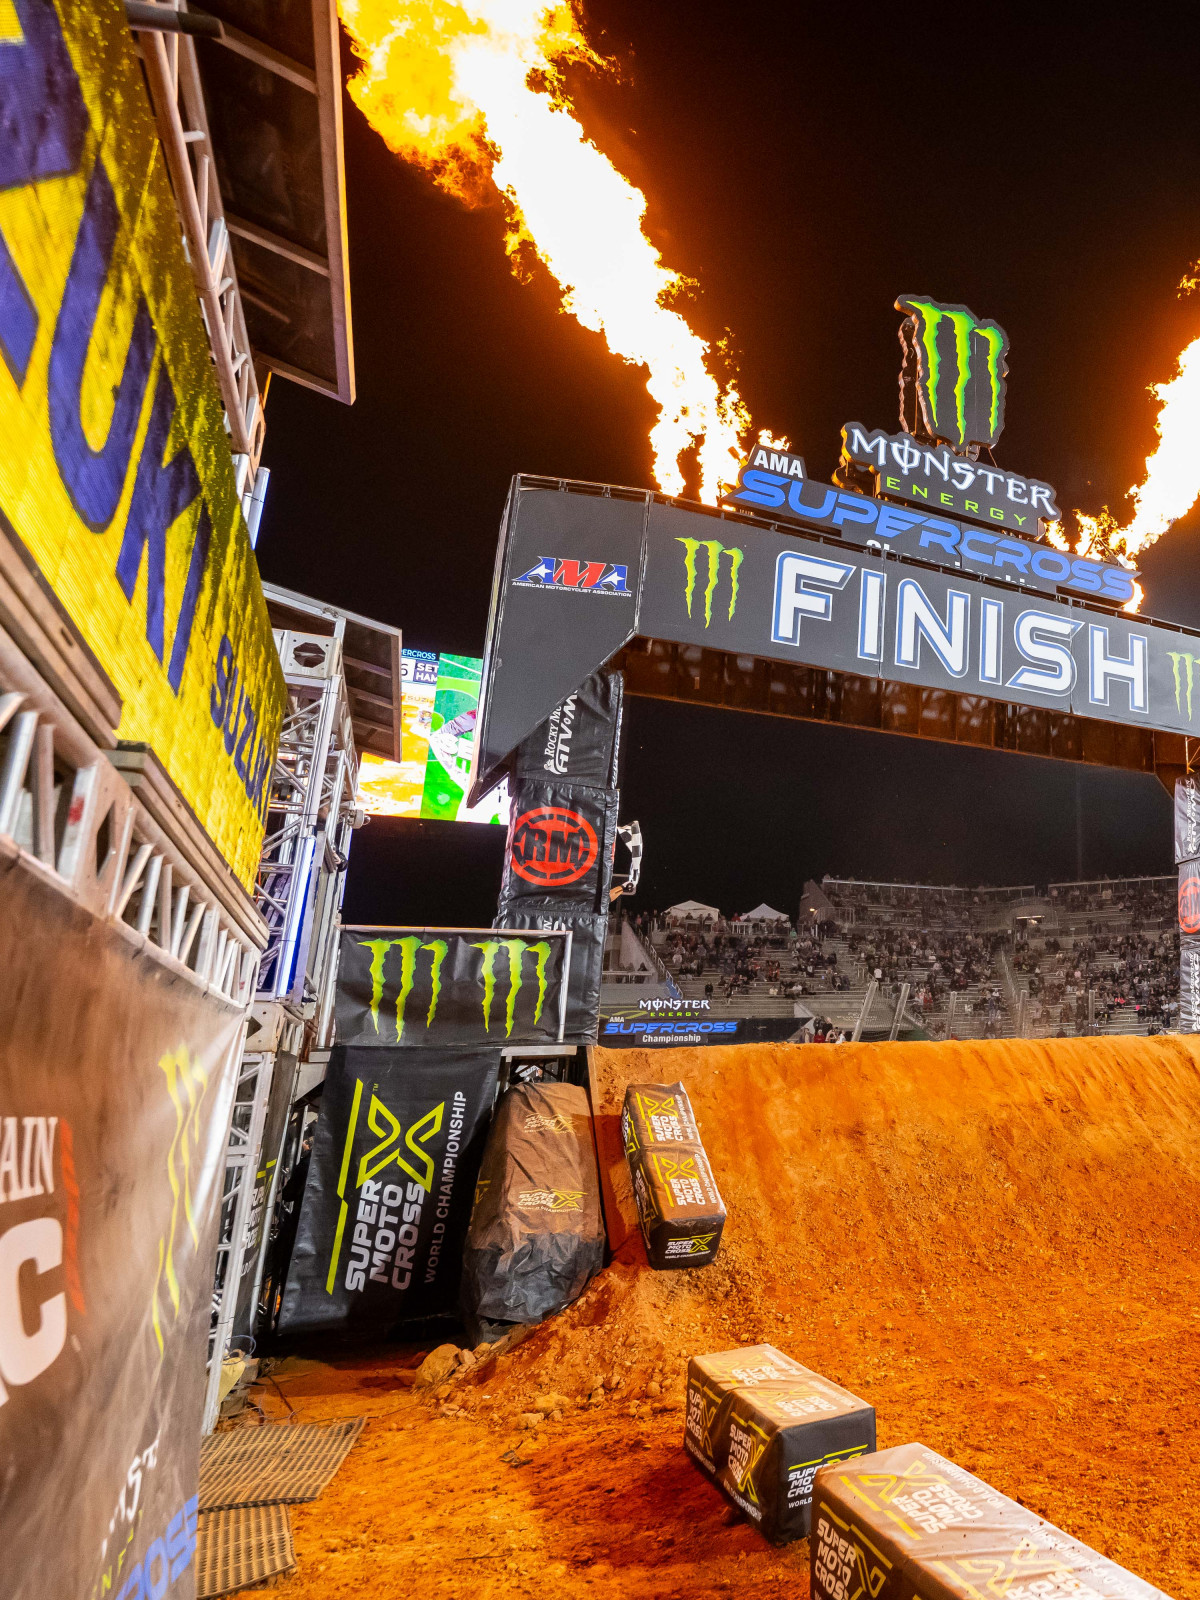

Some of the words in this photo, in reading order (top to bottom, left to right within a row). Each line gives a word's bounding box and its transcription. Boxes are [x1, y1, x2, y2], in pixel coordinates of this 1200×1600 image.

[753, 450, 804, 479] AMA
[850, 427, 1058, 516] MONSTER
[886, 476, 1028, 526] ENERGY
[735, 469, 1142, 599] SUPERCROSS
[511, 555, 632, 592] AMA
[512, 581, 545, 589] AMERICAN
[545, 585, 591, 594] MOTORCYCLIST
[592, 589, 632, 597] ASSOCIATION
[771, 550, 1150, 713] FINISH
[544, 723, 559, 758] ROCKY
[522, 828, 580, 864] RM
[639, 998, 710, 1011] MONSTER
[604, 1022, 738, 1034] SUPERCROSS
[642, 1035, 701, 1043] Championship
[669, 1116, 683, 1141] CROSS
[0, 1116, 58, 1202] AIN
[424, 1223, 445, 1284] WORLD
[436, 1091, 466, 1219] CHAMPIONSHIP
[671, 1178, 687, 1206] SUPER
[682, 1178, 696, 1204] MOTO
[691, 1178, 705, 1205] CROSS
[344, 1179, 382, 1292] SUPER
[369, 1184, 403, 1283] MOTO
[391, 1181, 425, 1290] CROSS
[729, 1423, 751, 1448] SUPER
[728, 1454, 744, 1485] CROSS
[730, 1444, 749, 1468] MOTO
[787, 1484, 814, 1499] CRO
[790, 1476, 815, 1490] MO
[788, 1496, 813, 1509] WORLD
[891, 1494, 947, 1534] SUPER
[911, 1490, 963, 1525] MOTO
[929, 1483, 984, 1520] CROSS
[816, 1517, 857, 1568] SUPER
[817, 1540, 852, 1586] MOTO
